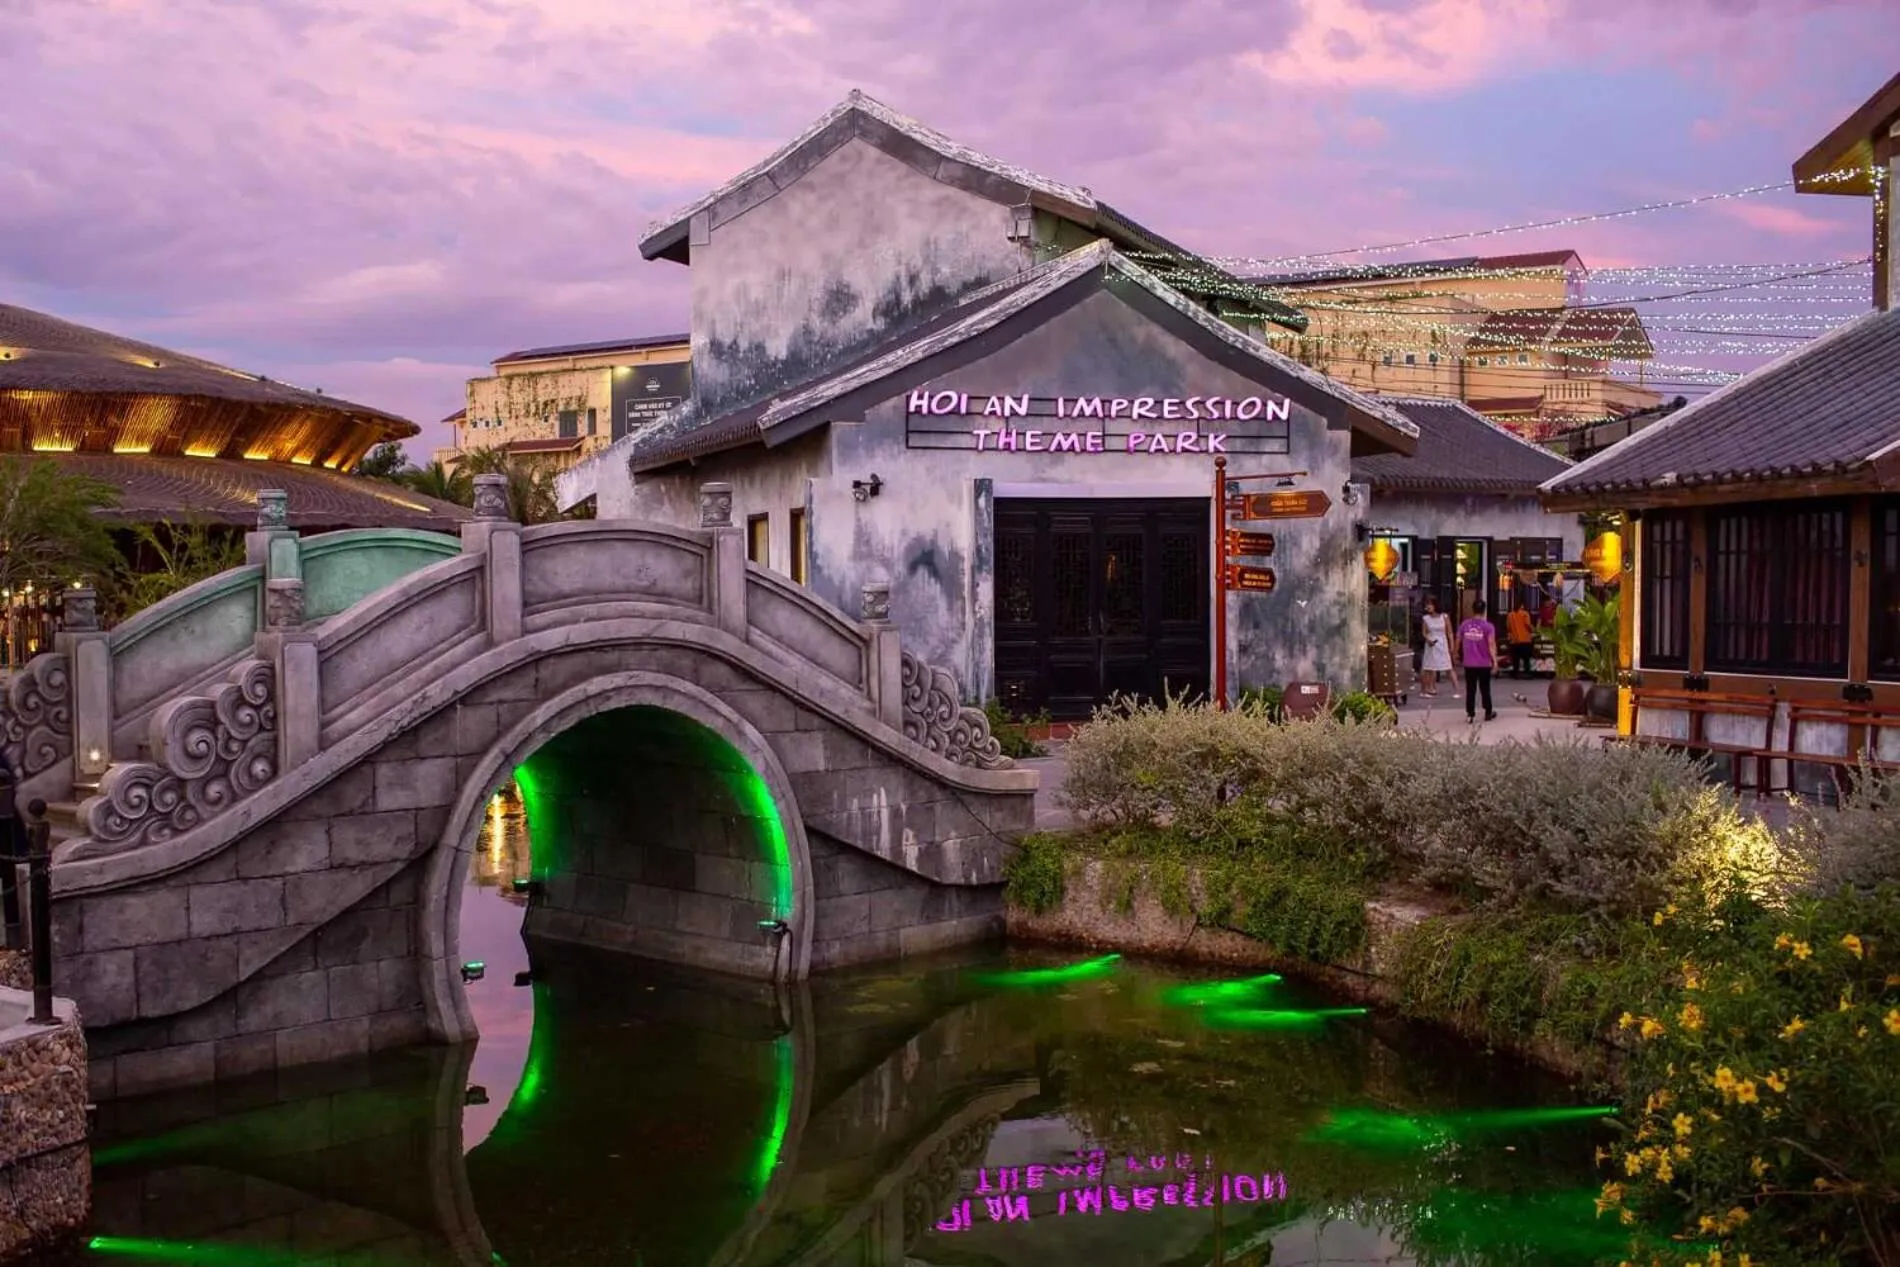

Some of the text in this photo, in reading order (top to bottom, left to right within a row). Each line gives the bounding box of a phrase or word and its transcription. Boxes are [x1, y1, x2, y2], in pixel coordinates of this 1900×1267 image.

[908, 390, 1290, 421] HOI AN IMPRESSION
[972, 428, 1228, 454] THEME PARK
